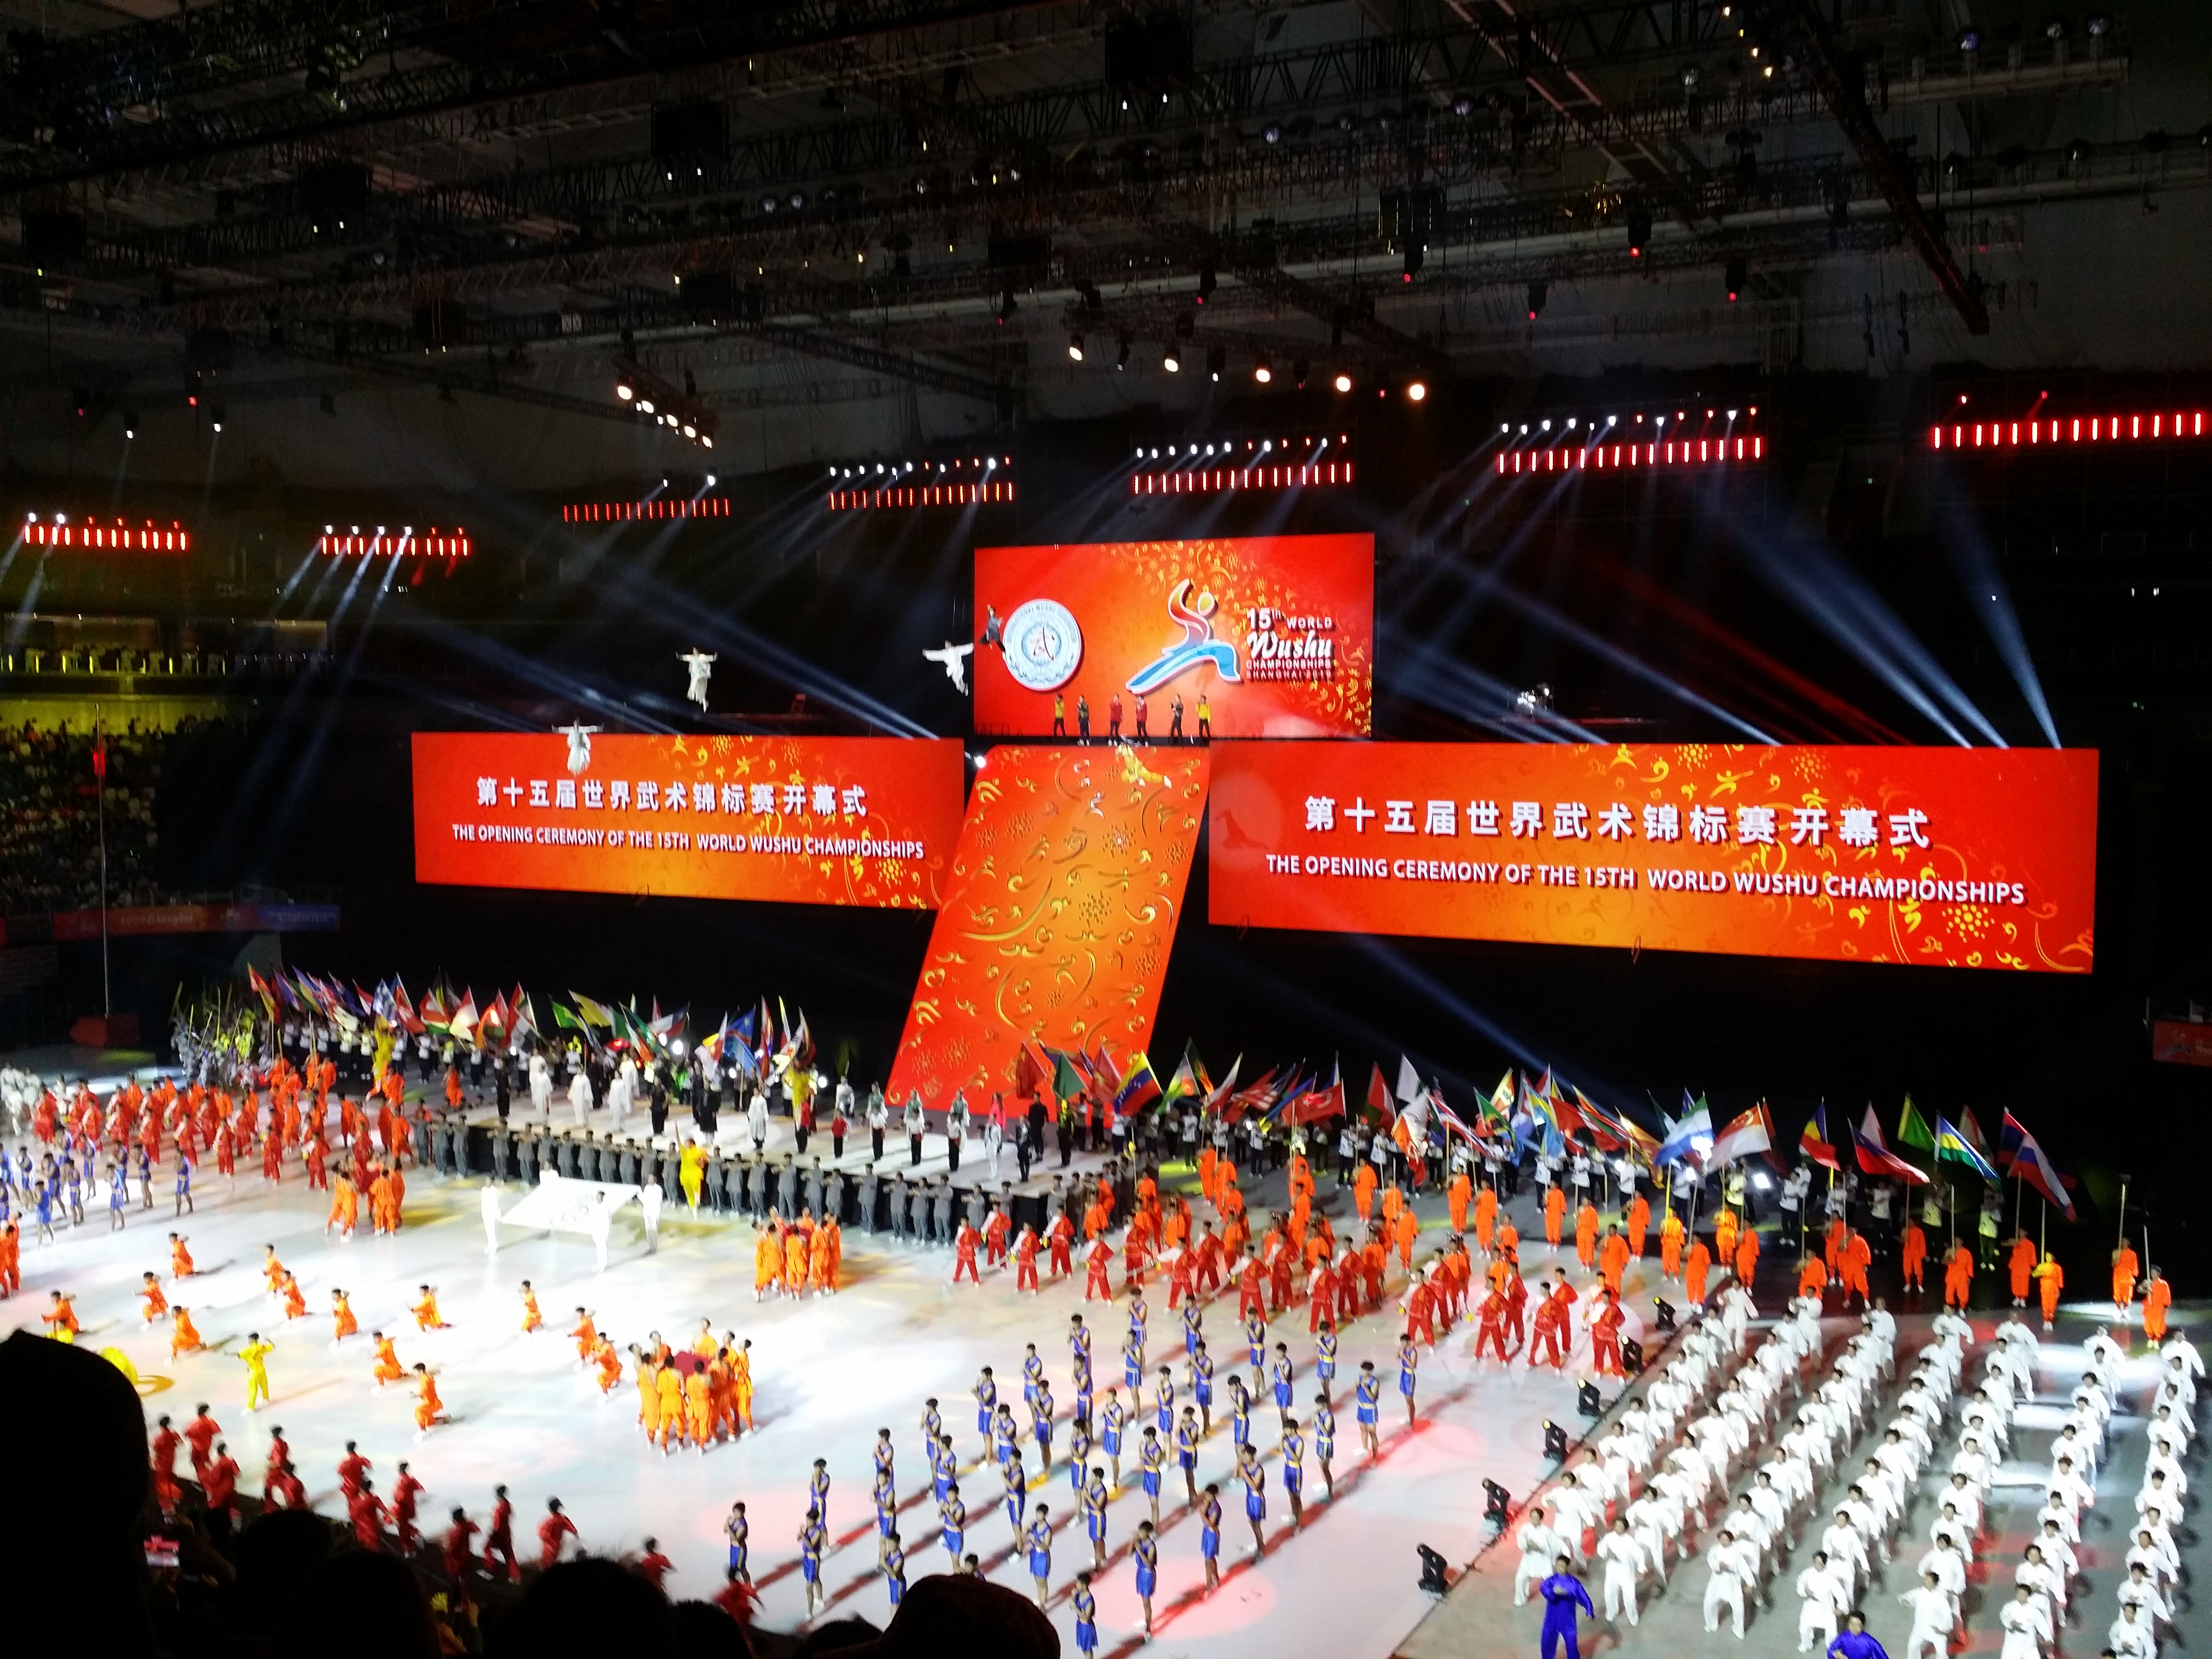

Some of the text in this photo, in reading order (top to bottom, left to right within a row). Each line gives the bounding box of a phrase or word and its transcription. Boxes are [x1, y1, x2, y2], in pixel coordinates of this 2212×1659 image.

[1246, 607, 1332, 629] 15th WORLD
[1246, 629, 1332, 659] Wushu
[1246, 659, 1332, 670] CHAMPIONSHIPS
[1246, 669, 1302, 679] SHANGHAI
[476, 776, 867, 817] 第十五届世界武术锦标赛开幕式
[1304, 795, 1931, 850] 第十五届世界武术锦标赛开幕式
[452, 824, 924, 859] THE OPENING CEREMONY OF THE 15TH WORLD WUSHU CHAMPIONSHIPS
[1266, 854, 2025, 905] THE OPENING CEREMONY OF THE 15TH WORLD WUSHU CHAMPIONSHIPS
